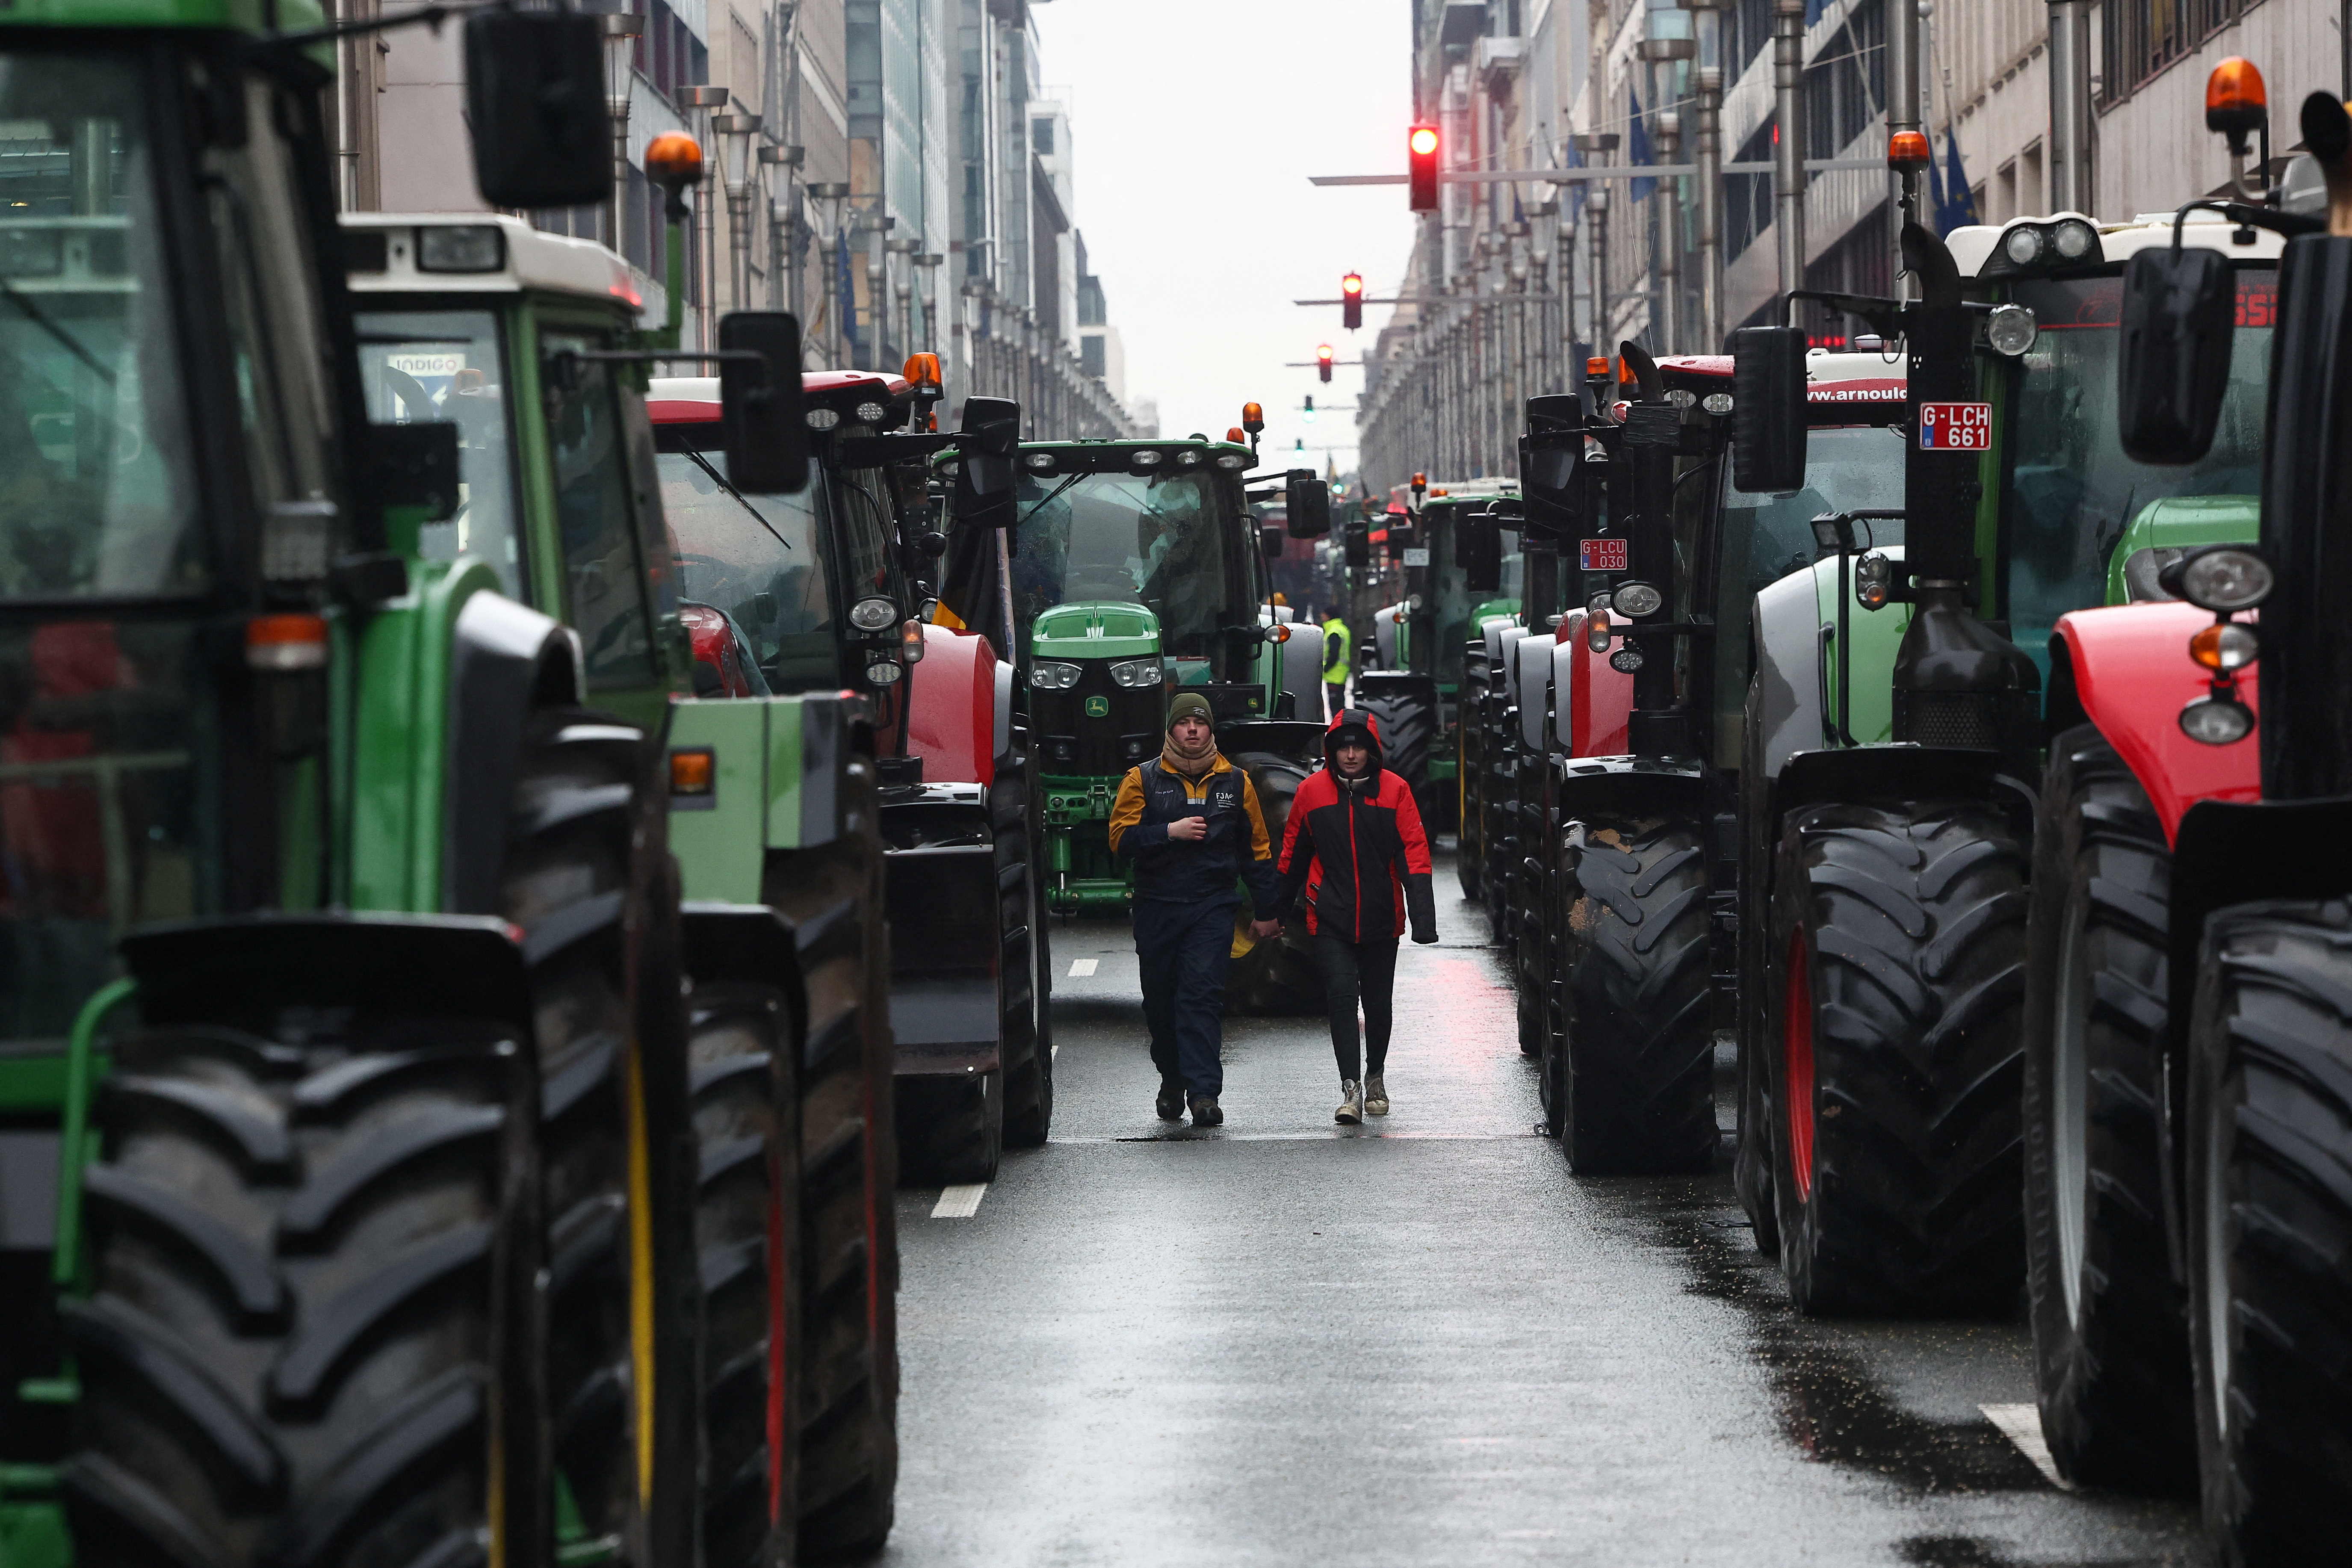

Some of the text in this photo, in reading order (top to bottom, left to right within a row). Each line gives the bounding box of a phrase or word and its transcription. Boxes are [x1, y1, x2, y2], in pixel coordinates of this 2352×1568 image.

[397, 358, 457, 371] INDIGO
[1924, 407, 1989, 426] G-LCH
[1948, 427, 1985, 446] 661
[1583, 541, 1624, 553] G-LCU
[1600, 556, 1624, 567] 030
